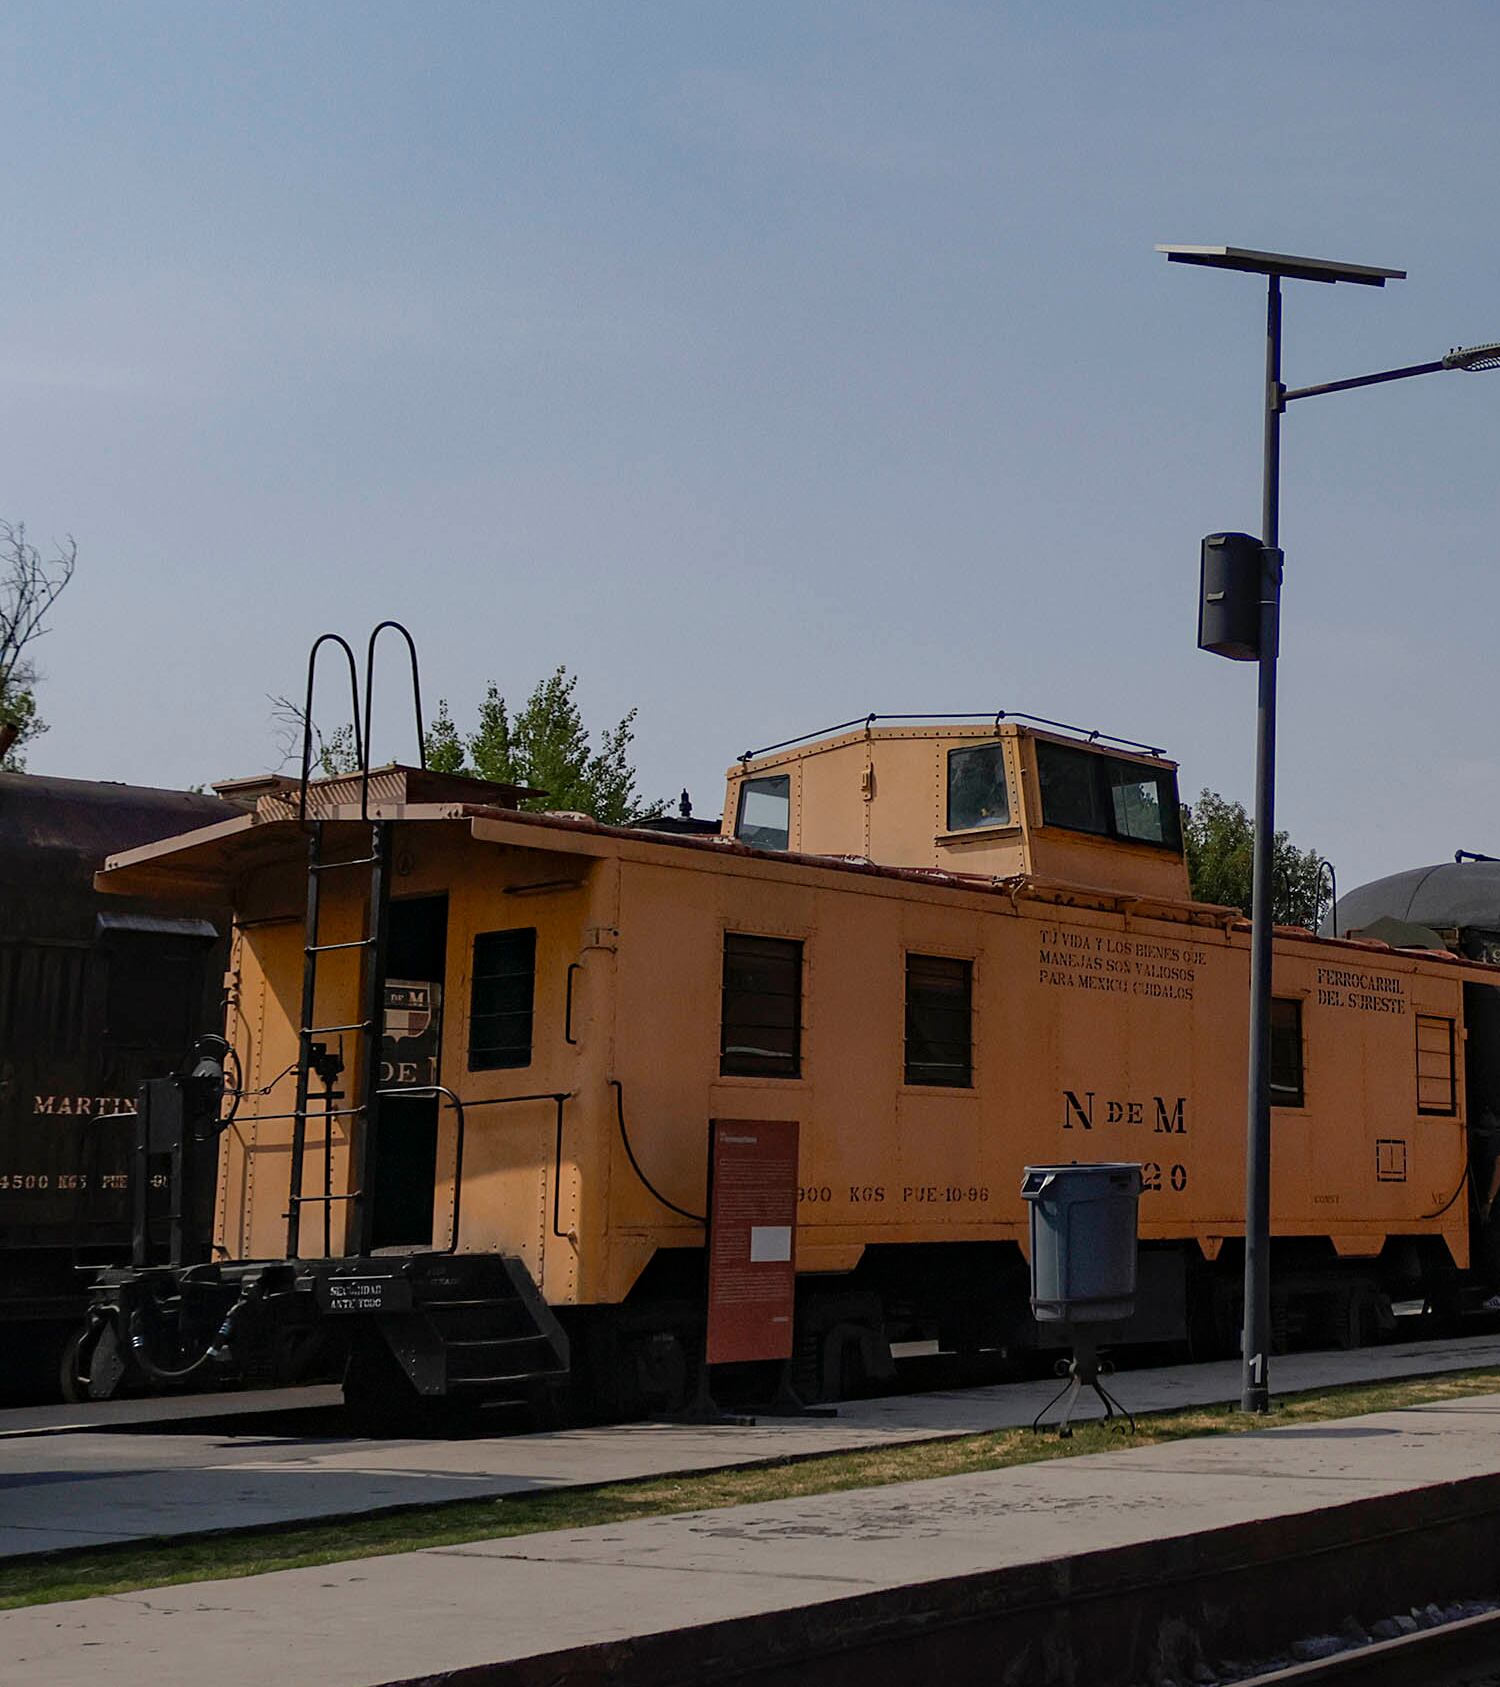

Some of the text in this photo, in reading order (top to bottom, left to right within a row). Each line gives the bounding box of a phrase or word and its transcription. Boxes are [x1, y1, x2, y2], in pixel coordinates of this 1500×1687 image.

[1062, 932, 1091, 950] VIDA
[1096, 937, 1102, 951] Y
[1107, 939, 1132, 955] LOS
[1135, 943, 1180, 962] BIENES
[1040, 950, 1195, 982] MANEJAS SON VALIOSOS
[1040, 969, 1074, 986] PARA
[1078, 974, 1128, 993] MEXICO
[1318, 968, 1404, 995] FERROCARRIL
[1318, 989, 1405, 1015] DEL SURESTE
[1062, 1090, 1187, 1134] N DE M
[850, 1186, 885, 1202] KGS
[1248, 1353, 1262, 1384] 1
